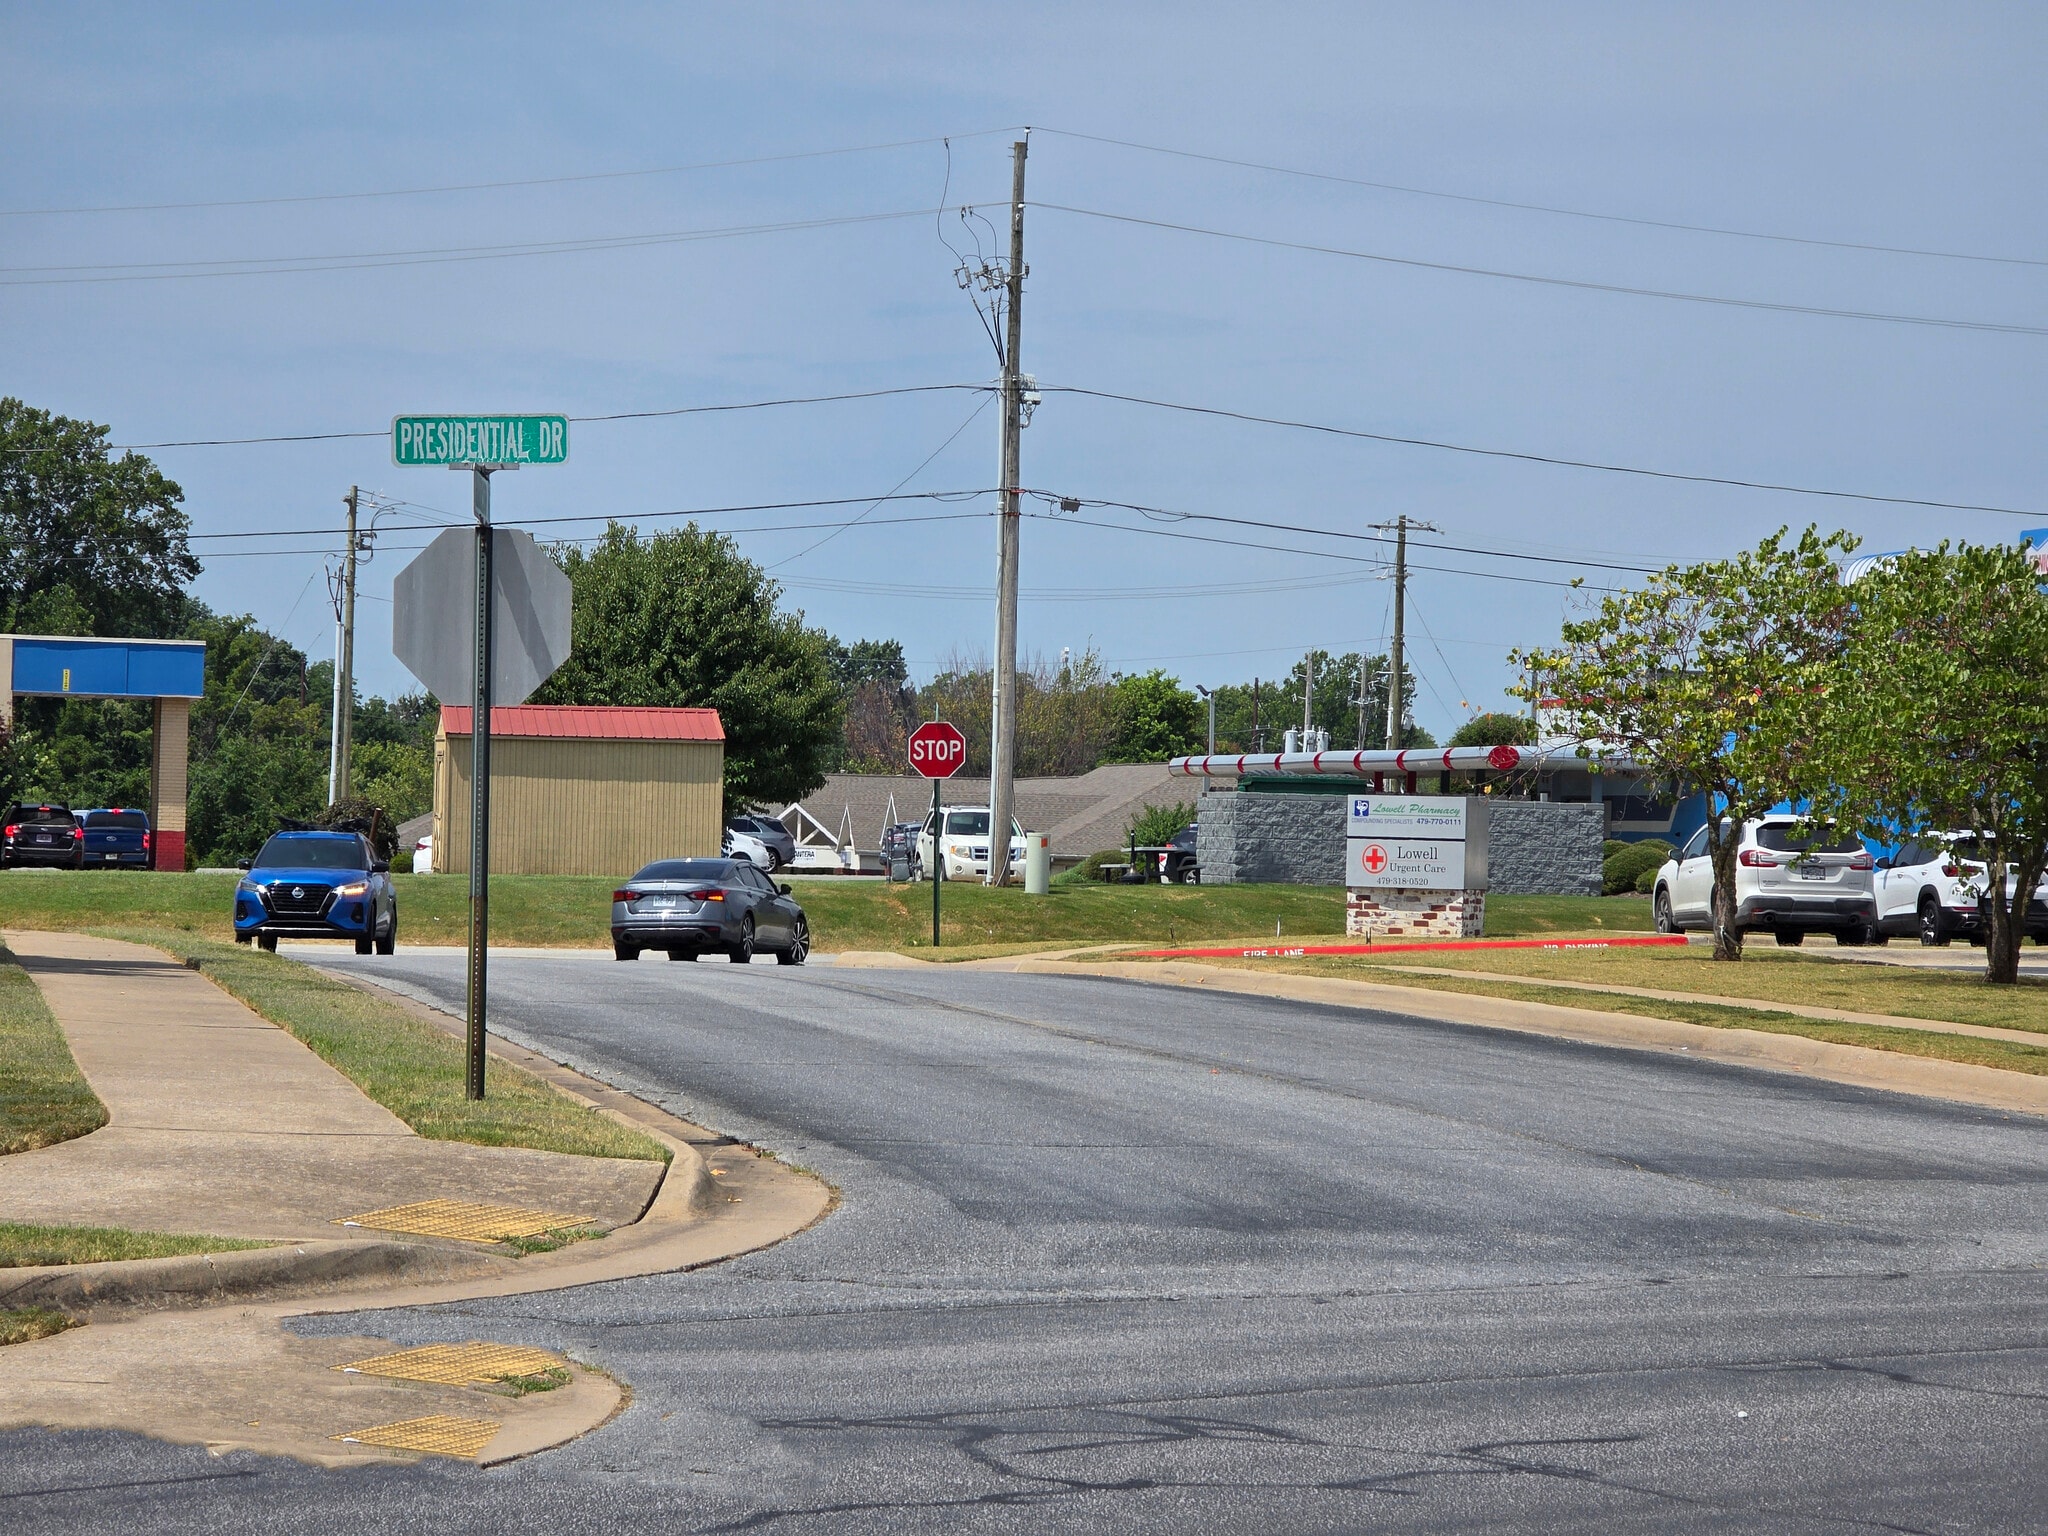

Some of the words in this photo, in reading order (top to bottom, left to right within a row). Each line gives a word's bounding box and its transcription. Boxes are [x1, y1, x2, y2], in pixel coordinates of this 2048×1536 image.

[401, 421, 529, 459] PRESIDENTIAL
[539, 421, 563, 458] DR
[913, 739, 961, 761] STOP
[1372, 803, 1406, 814] Lowell
[1409, 803, 1461, 817] Pharmacy
[1351, 817, 1384, 825] COMPOUNDING
[1397, 846, 1438, 860] Lowell
[1390, 863, 1421, 873] Urgent
[1424, 863, 1447, 873] Care
[1377, 877, 1429, 886] 479-318-0520
